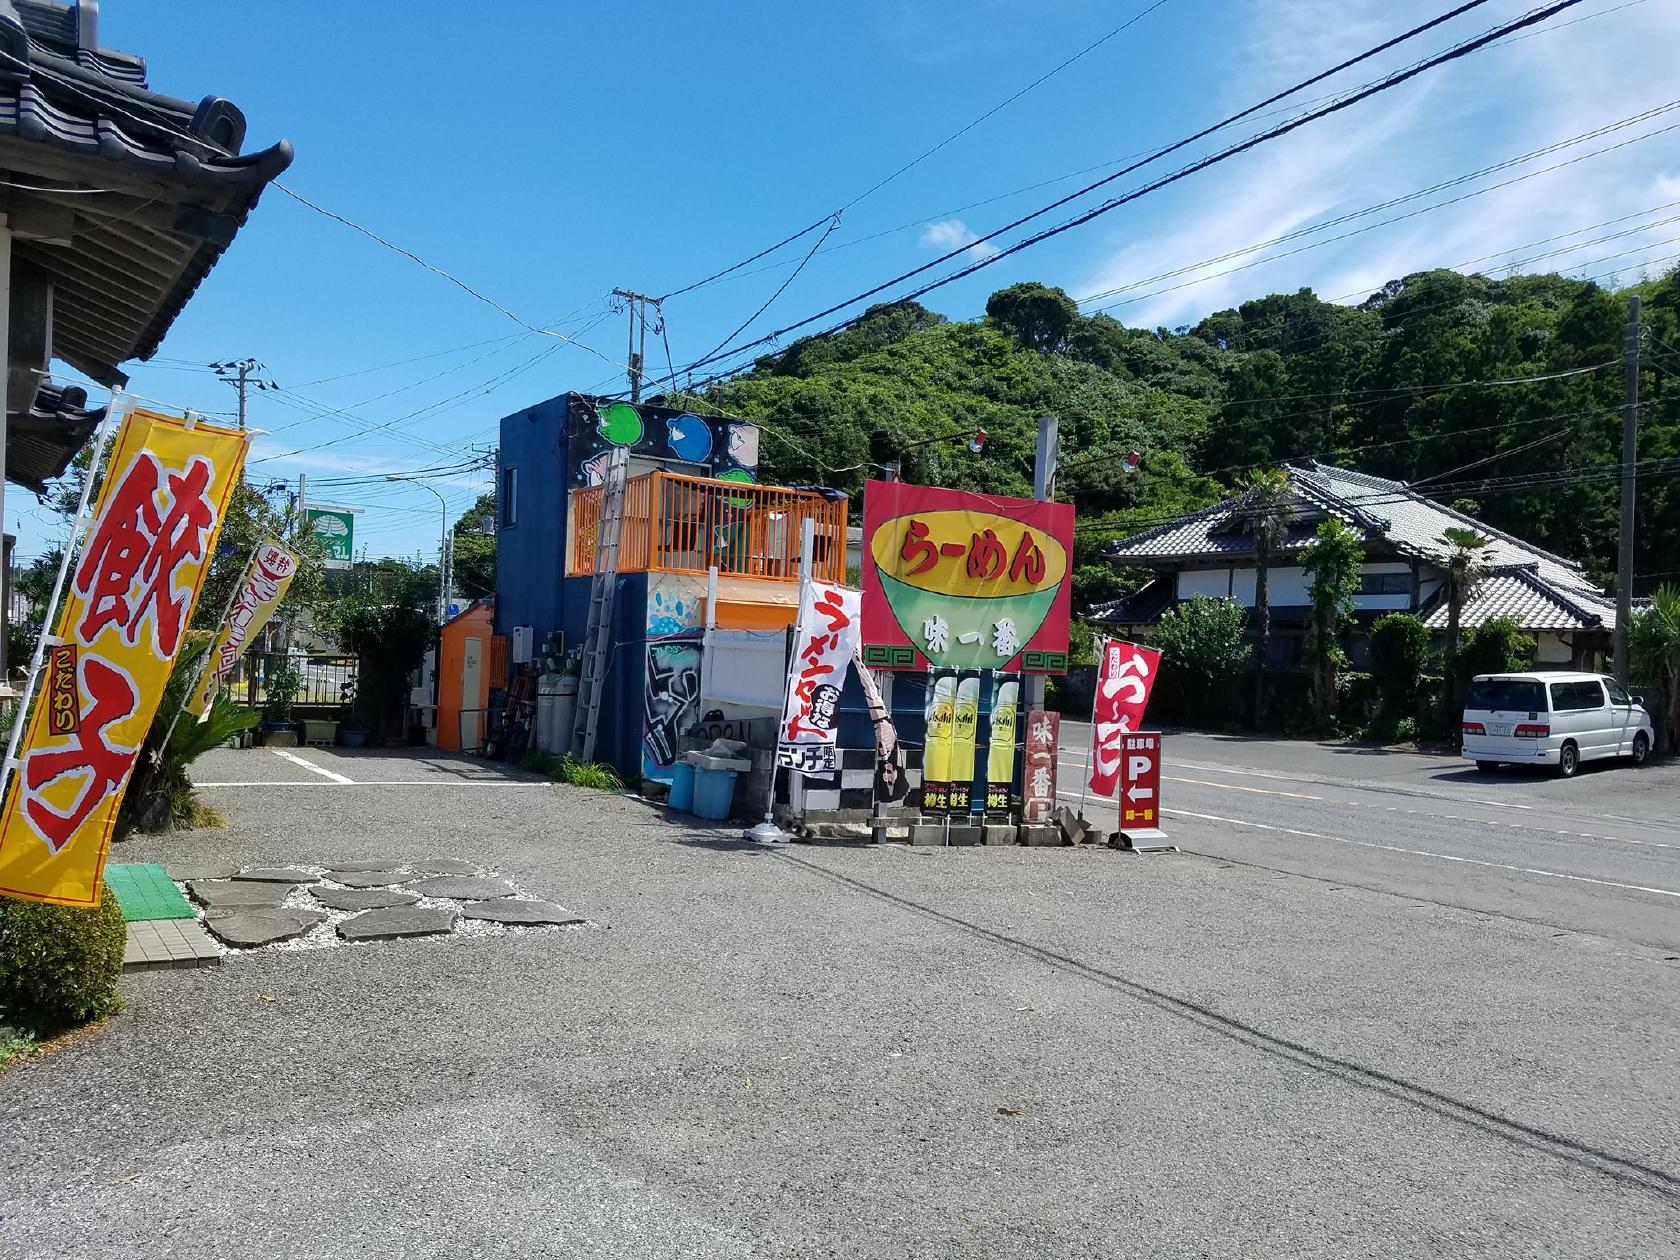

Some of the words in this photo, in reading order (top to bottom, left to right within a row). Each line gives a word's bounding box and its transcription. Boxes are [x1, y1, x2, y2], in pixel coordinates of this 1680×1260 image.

[901, 519, 1046, 585] らーめん
[923, 615, 1021, 657] 味一番
[1109, 648, 1119, 679] こだわり
[53, 649, 75, 731] こだわり
[955, 712, 973, 725] sahi
[1029, 715, 1054, 797] 味一番
[1129, 756, 1152, 781] P
